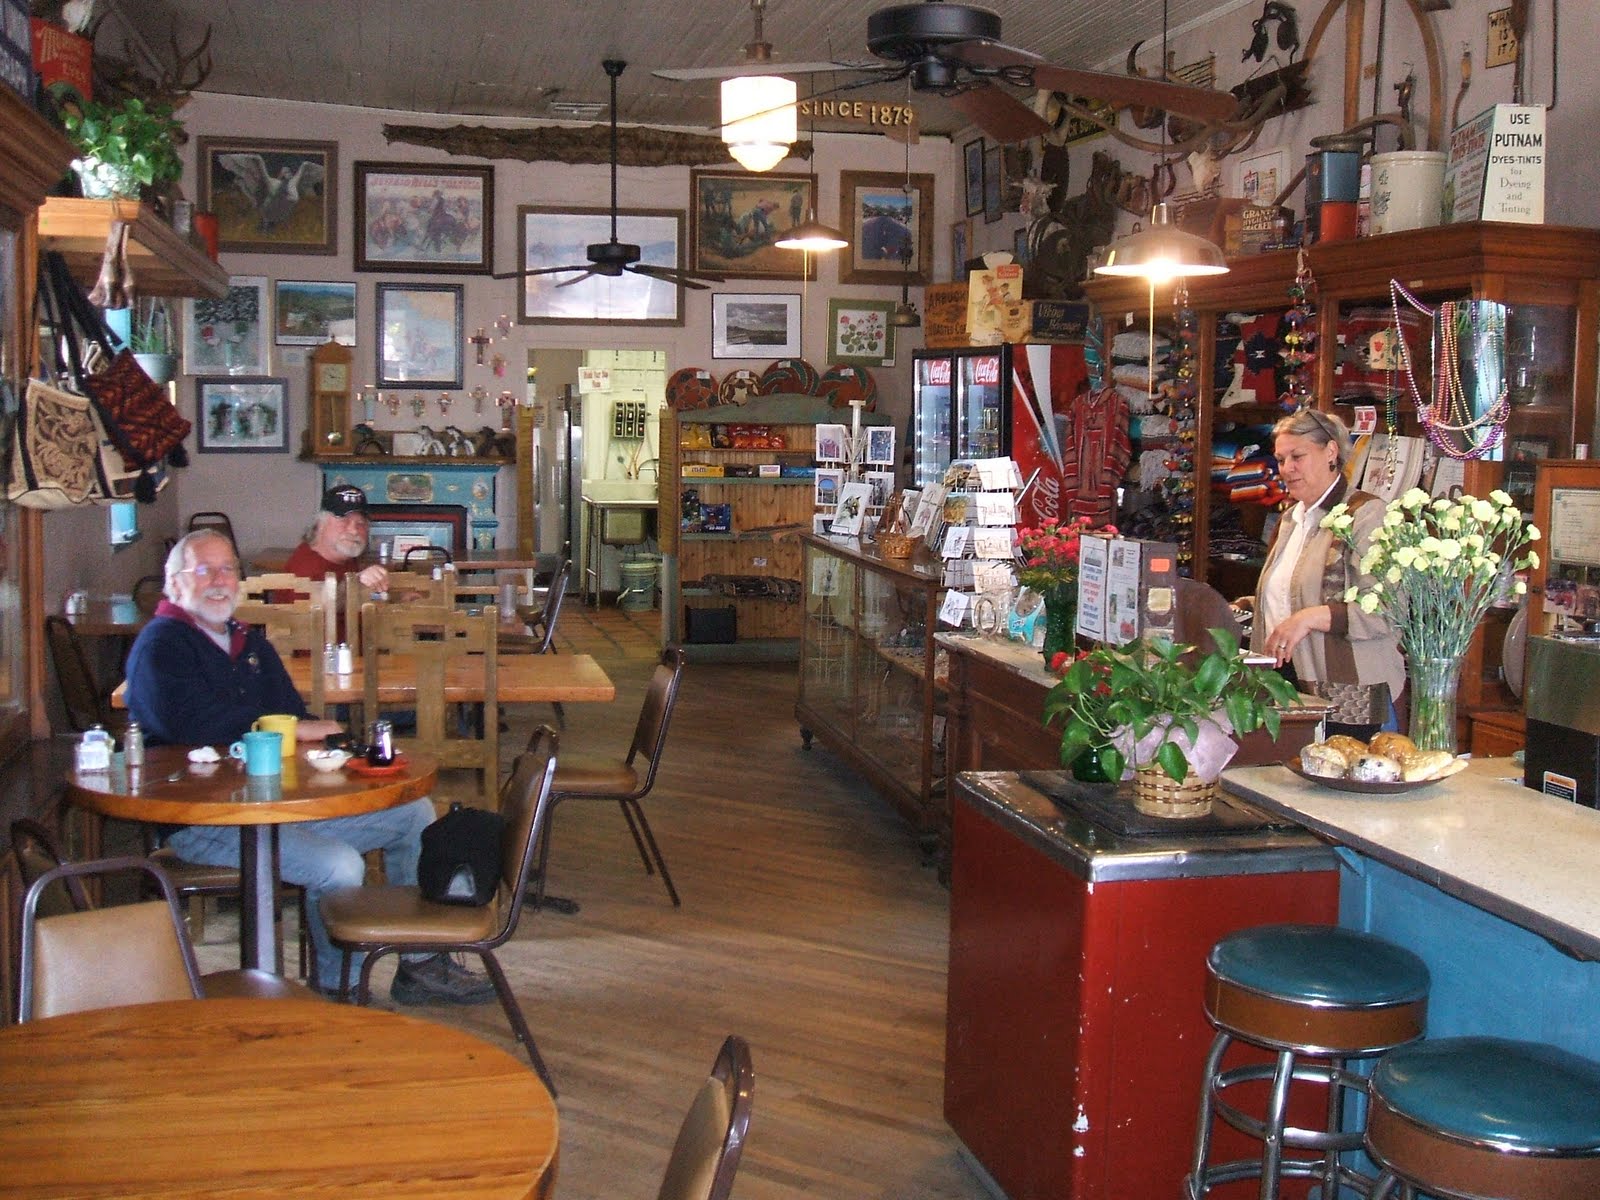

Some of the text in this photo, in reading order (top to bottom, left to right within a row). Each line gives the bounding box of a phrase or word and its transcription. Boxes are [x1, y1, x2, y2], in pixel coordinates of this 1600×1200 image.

[801, 101, 913, 125] SINCE 1879
[1510, 113, 1530, 125] USE
[1495, 133, 1543, 148] PUTNAM
[1491, 156, 1542, 165] DYES-TINTS
[1510, 167, 1522, 175] for
[1499, 178, 1532, 189] Dyeing
[1506, 193, 1522, 201] and
[1499, 203, 1532, 215] Tinting
[975, 358, 999, 383] Coca-Cola
